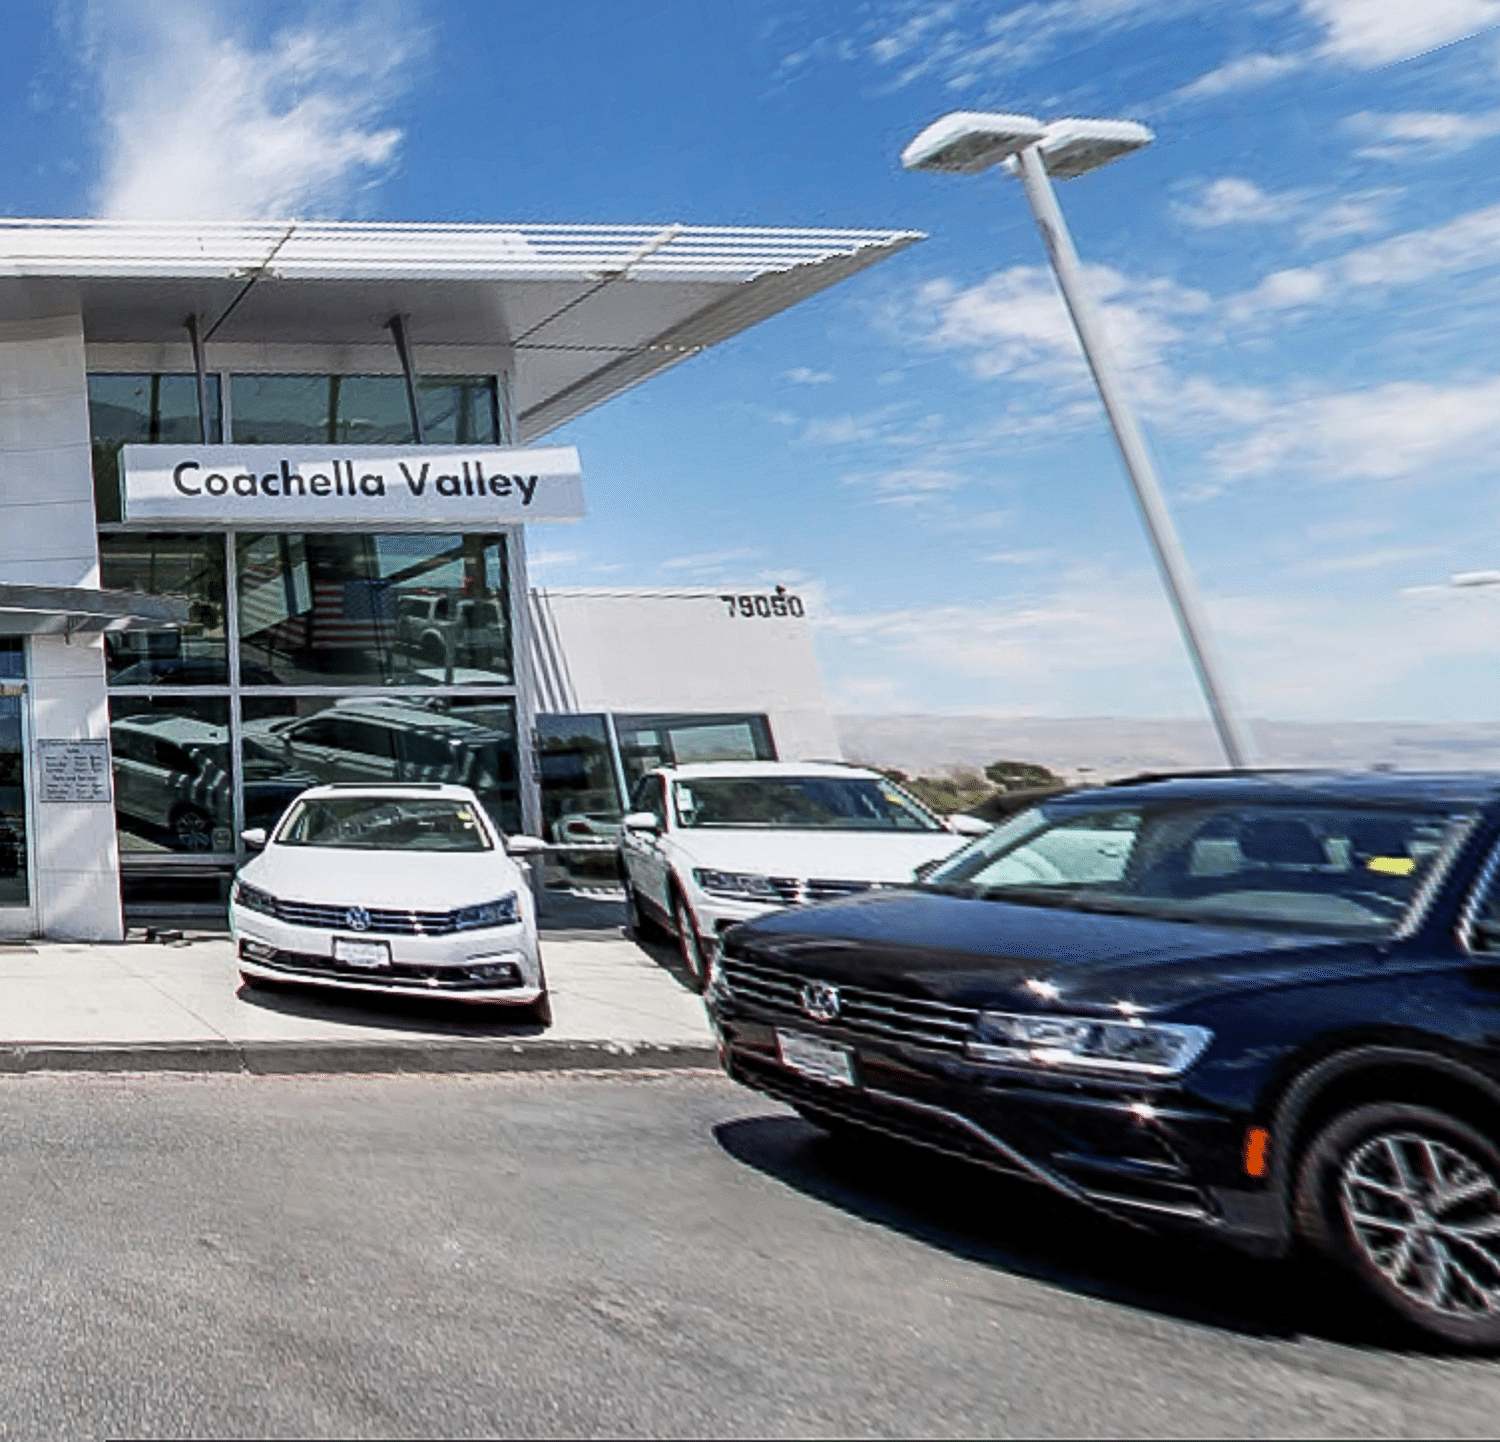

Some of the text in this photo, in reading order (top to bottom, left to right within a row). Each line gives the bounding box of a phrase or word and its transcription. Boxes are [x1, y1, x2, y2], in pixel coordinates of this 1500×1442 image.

[172, 459, 539, 506] Coachella Valley
[719, 594, 805, 618] 79050
